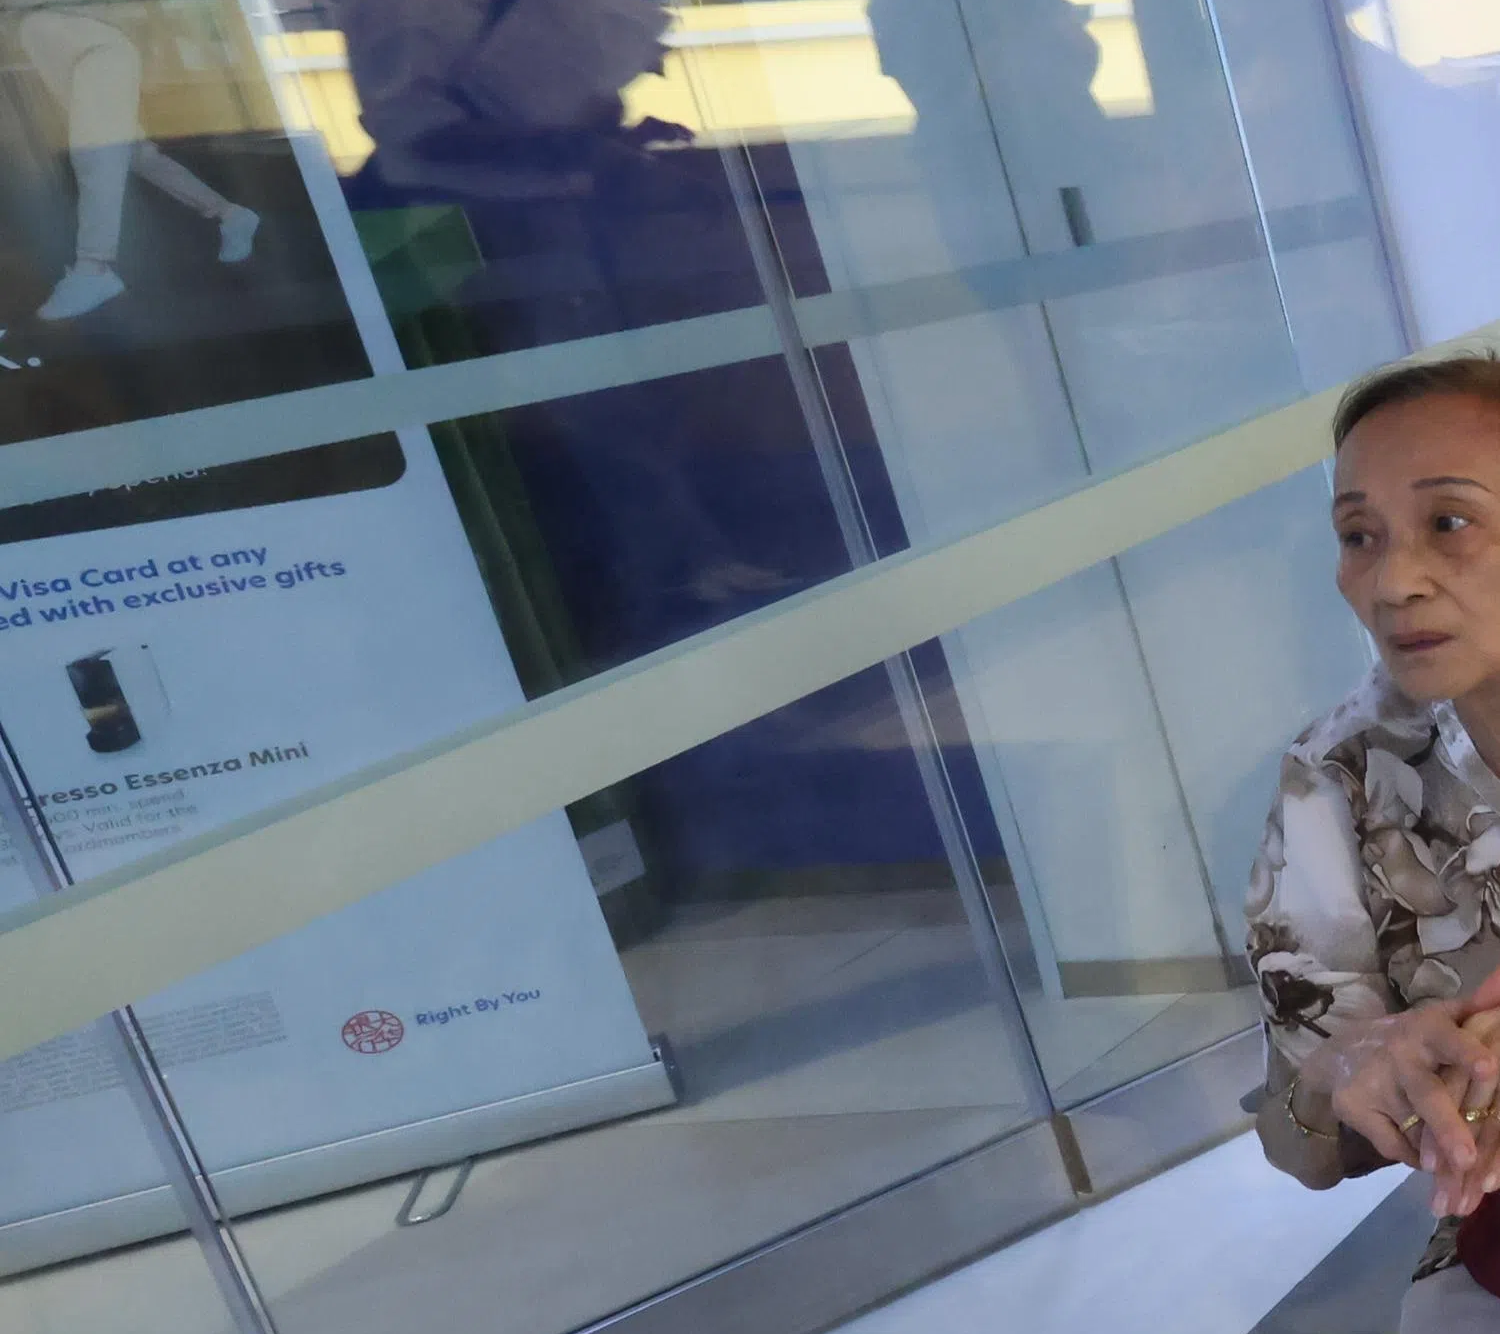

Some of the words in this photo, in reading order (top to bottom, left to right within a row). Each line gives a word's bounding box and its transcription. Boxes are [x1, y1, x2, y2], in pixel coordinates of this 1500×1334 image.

[1, 576, 72, 602] Visa
[79, 559, 160, 588] Card
[167, 554, 202, 575] at
[210, 546, 268, 569] any
[39, 595, 116, 624] with
[122, 575, 268, 611] exclusive
[275, 559, 347, 591] gifts
[124, 756, 243, 791] Essenza
[249, 741, 311, 768] Mini
[82, 815, 132, 834] Valid
[169, 803, 198, 818] the
[416, 1004, 471, 1026] Right
[474, 998, 499, 1013] By
[502, 988, 541, 1004] You
